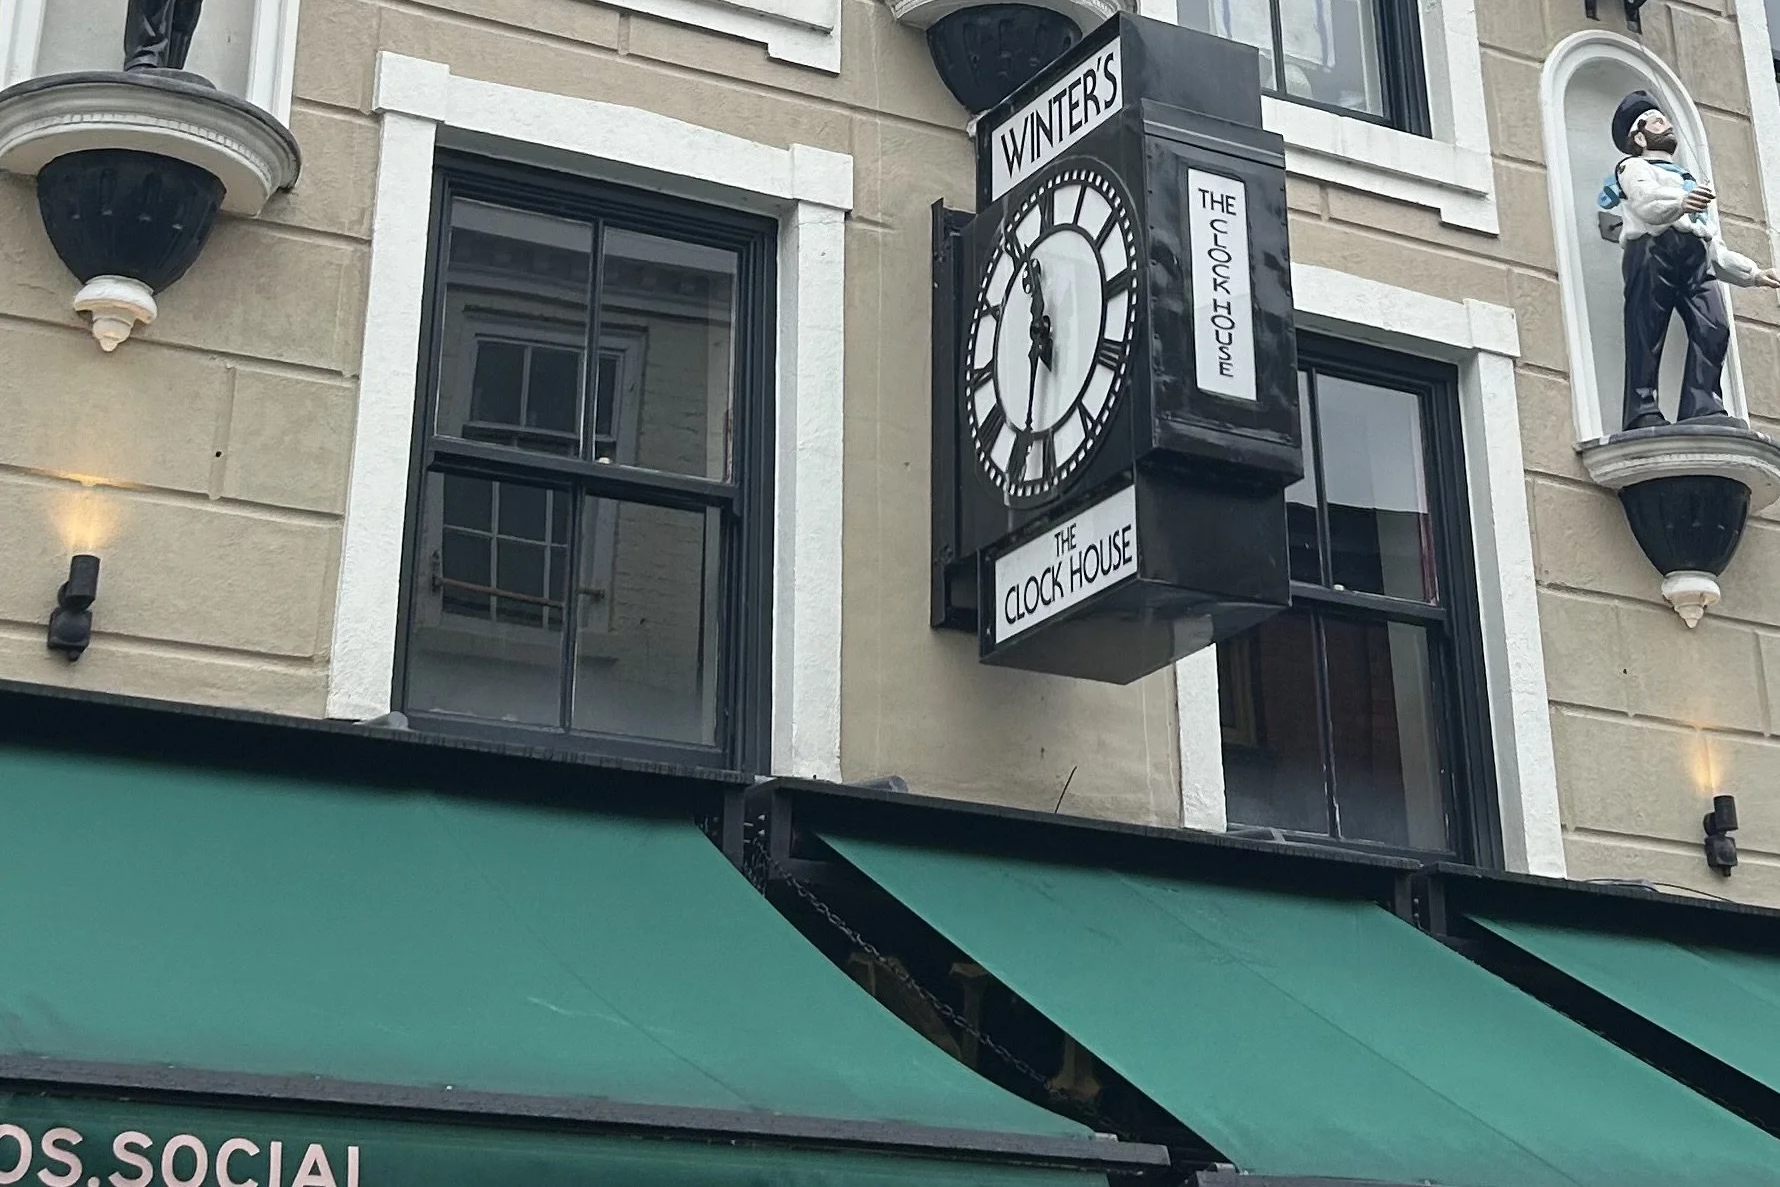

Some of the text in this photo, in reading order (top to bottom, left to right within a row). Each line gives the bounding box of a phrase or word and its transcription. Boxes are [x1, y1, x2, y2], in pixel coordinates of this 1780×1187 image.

[1001, 52, 1118, 179] WINTER'S
[1198, 188, 1237, 216] THE
[1207, 219, 1236, 378] CLOCK HOUSE
[1005, 524, 1132, 624] CLOCK HOUSE
[1054, 523, 1077, 557] THE
